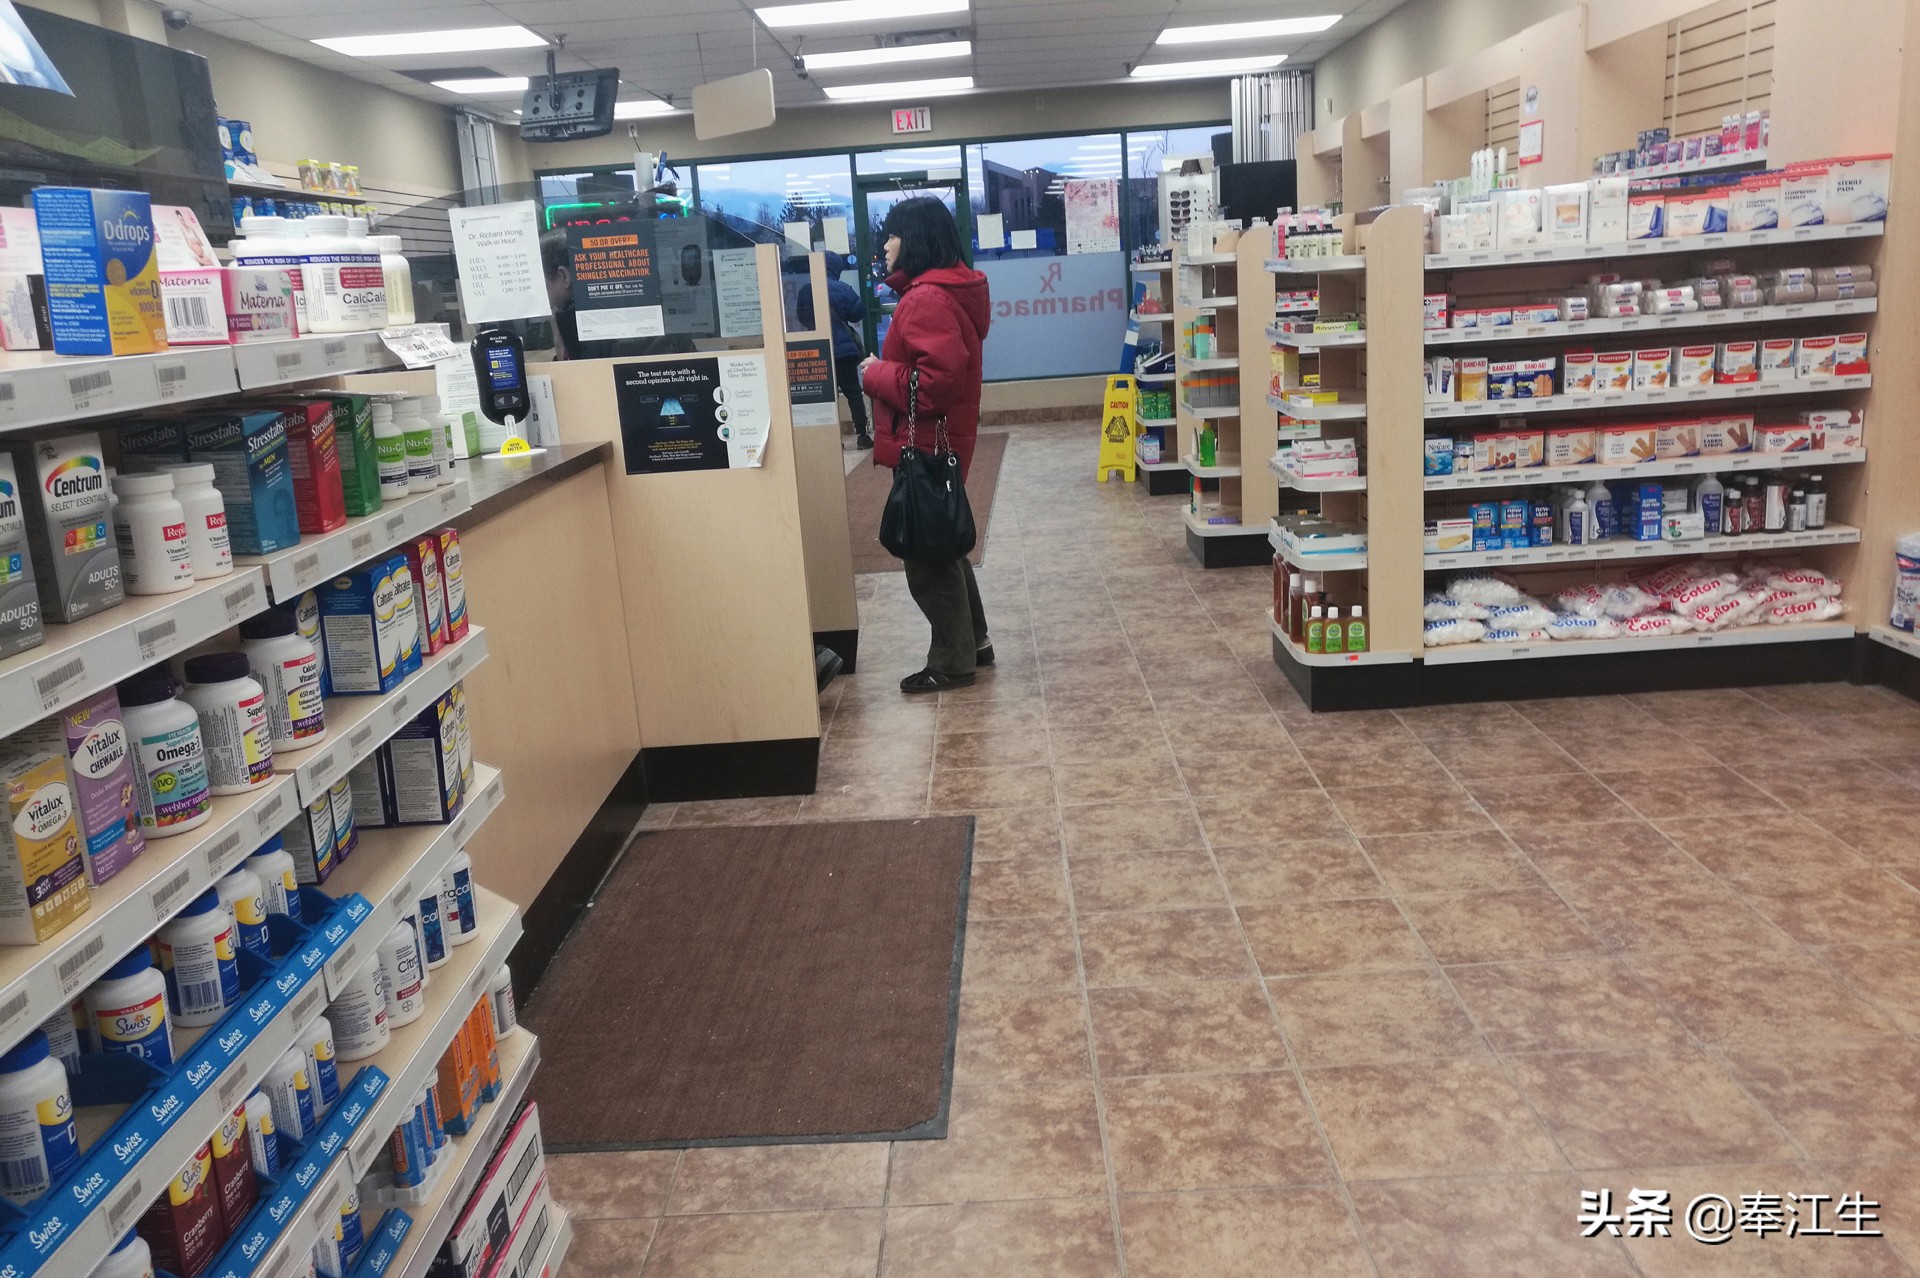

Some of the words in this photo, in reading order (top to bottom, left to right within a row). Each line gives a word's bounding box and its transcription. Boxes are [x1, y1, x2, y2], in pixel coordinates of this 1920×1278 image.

[895, 108, 925, 131] EXIT
[104, 220, 150, 246] Ddrops
[479, 229, 503, 239] Richard
[503, 229, 523, 238] Wong
[610, 237, 631, 245] OVER?
[477, 239, 500, 248] Walk-in
[575, 253, 587, 262] ASK
[589, 251, 607, 261] YOUR
[608, 248, 649, 259] HEALTHCARE
[575, 260, 625, 271] PROFESSIONAL
[628, 258, 650, 268] ABOUT
[576, 270, 607, 281] SHINGLES
[240, 290, 286, 312] Materna
[1727, 343, 1754, 351] Elastoplast
[1802, 339, 1834, 348] Elastoplast
[1839, 334, 1865, 343] Elastoplast
[1567, 355, 1594, 363] Elastoplast
[1598, 353, 1629, 362] Elastoplast
[1638, 351, 1668, 360] Elastoplast
[1684, 347, 1713, 357] Elastoplast
[626, 378, 647, 386] second
[648, 377, 671, 386] opinion
[686, 374, 700, 382] right
[662, 369, 676, 377] strip
[1110, 401, 1129, 409] CAUTION
[120, 424, 178, 451] Stresstabs
[187, 421, 241, 449] Stresstabs
[248, 420, 285, 454] Stresstabs
[1428, 442, 1451, 452] Nexcare
[263, 453, 276, 466] MEN
[54, 474, 102, 498] Centrum
[76, 492, 109, 507] ESSENTIALS
[445, 552, 461, 568] Caltrate
[88, 565, 119, 584] ADULTS
[104, 579, 120, 591] 50+
[1679, 579, 1721, 604] Coton
[0, 601, 38, 625] ADULTS
[70, 602, 78, 613] 60
[20, 616, 39, 631] 50+
[300, 690, 309, 699] 650
[70, 708, 91, 727] NEW
[156, 735, 200, 762] Omega-3
[90, 747, 124, 774] CHEWABLE
[11, 784, 26, 796] NEW
[161, 799, 191, 815] webber
[38, 811, 68, 834] OMEGA-3
[132, 841, 145, 853] Alcon
[97, 866, 105, 876] 50
[35, 886, 42, 899] 3
[41, 879, 50, 888] PER
[41, 884, 51, 895] DAY
[348, 903, 365, 920] Swiss
[303, 947, 322, 967] Swiss
[120, 1004, 145, 1014] VALUE
[249, 1000, 271, 1022] Swiss
[115, 1015, 152, 1036] Swiss
[187, 1061, 212, 1085] Swiss
[364, 1075, 381, 1096] Swiss
[152, 1095, 178, 1122] Swiss
[343, 1102, 361, 1123] Swiss
[223, 1118, 239, 1146] Swiss
[114, 1132, 142, 1161] Swiss
[320, 1131, 339, 1154] Swiss
[182, 1162, 201, 1192] Swiss
[224, 1159, 249, 1194] Cranberry
[296, 1162, 316, 1186] Swiss
[73, 1173, 104, 1203] Swiss
[270, 1196, 291, 1221] Swiss
[30, 1217, 61, 1249] Swiss
[183, 1205, 213, 1243] Cranberry
[389, 1219, 405, 1240] Swiss
[241, 1231, 264, 1259] Swiss
[371, 1249, 387, 1272] Swiss
